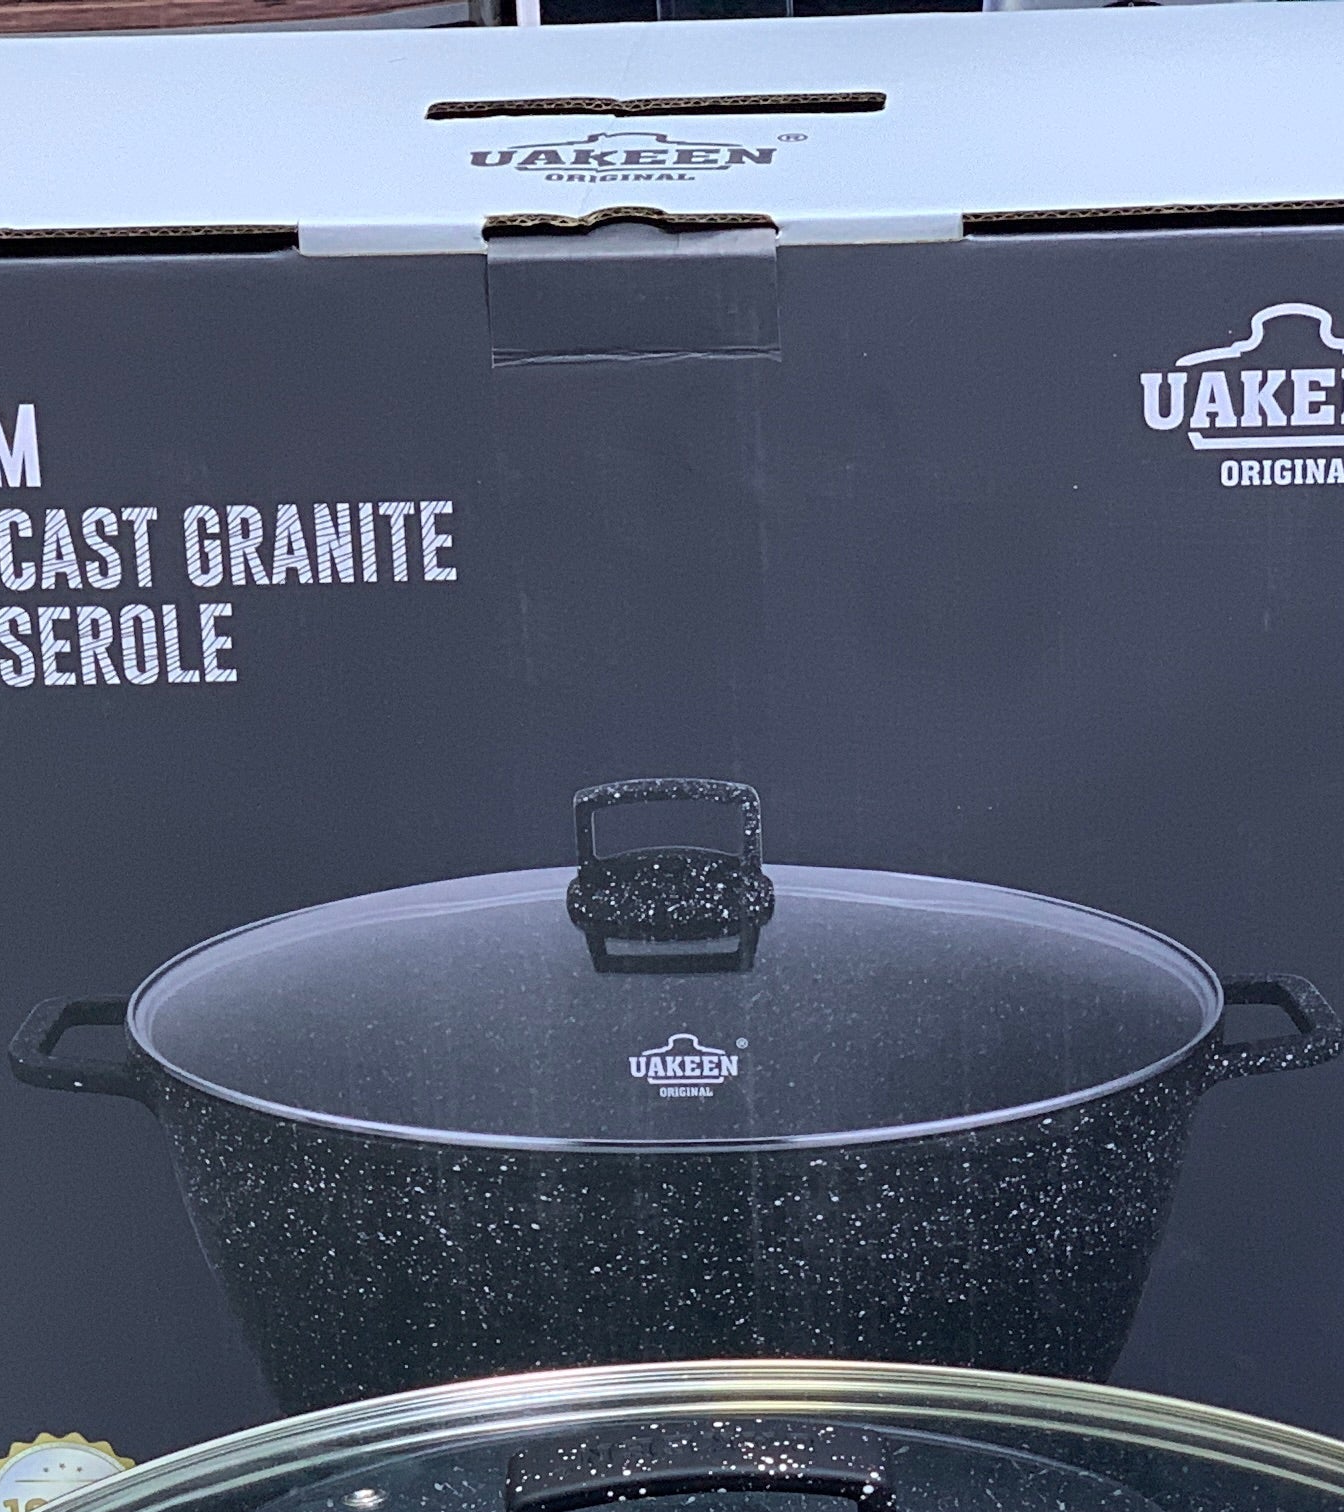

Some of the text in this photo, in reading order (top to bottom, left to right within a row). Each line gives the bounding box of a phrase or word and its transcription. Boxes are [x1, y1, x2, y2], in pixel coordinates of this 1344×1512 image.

[469, 147, 777, 168] UAKEEN
[545, 172, 696, 184] ORIGINAL
[182, 500, 457, 587] GRANITE
[628, 1055, 739, 1078] UAKEEN
[659, 1086, 714, 1098] ORIGINAL
